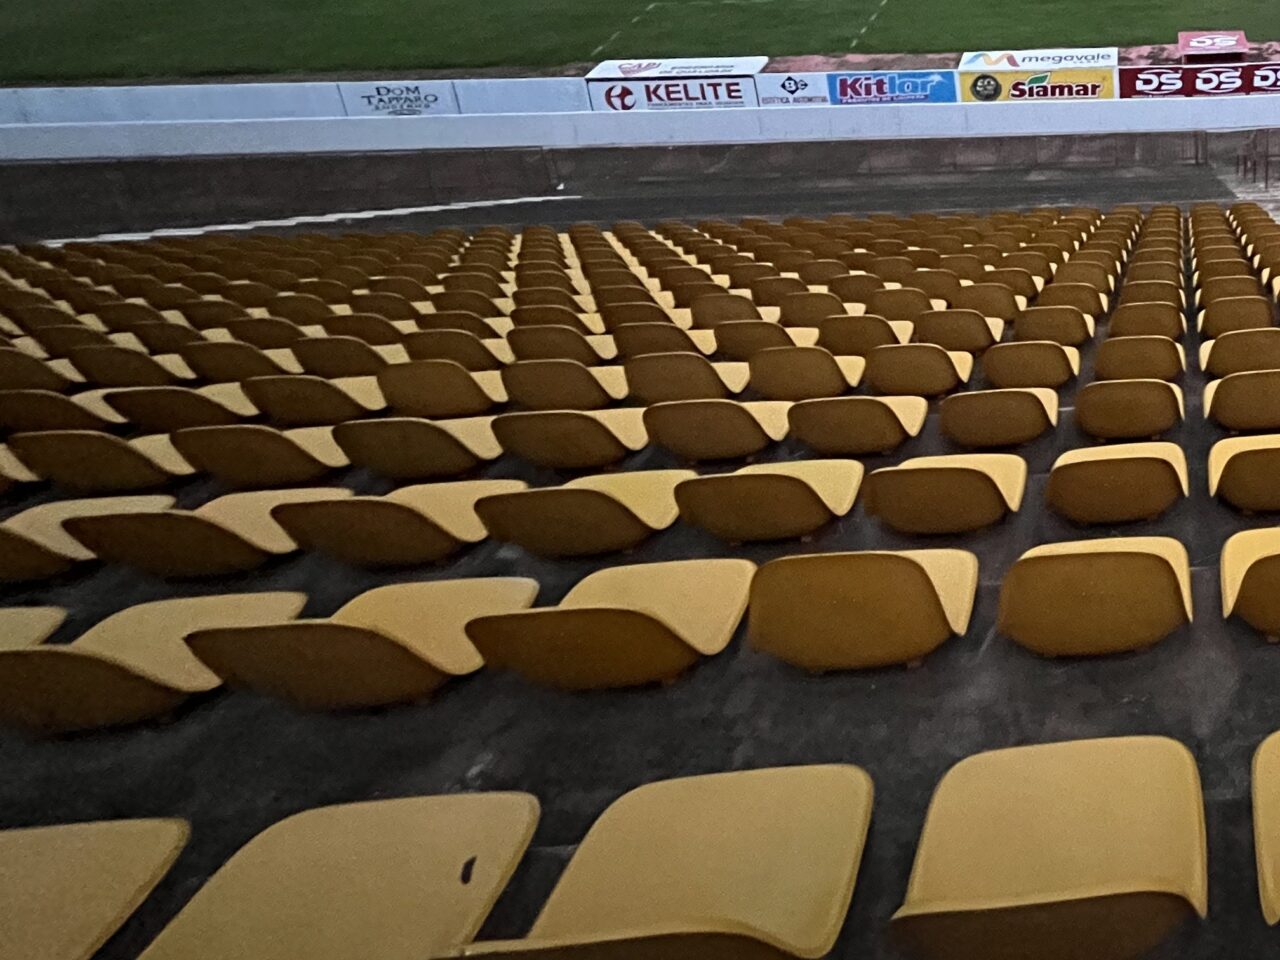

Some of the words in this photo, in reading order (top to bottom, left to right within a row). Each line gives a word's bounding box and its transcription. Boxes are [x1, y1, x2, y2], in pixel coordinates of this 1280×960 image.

[1189, 35, 1240, 47] DS
[1021, 53, 1111, 64] megavale
[1136, 70, 1183, 91] DS
[1195, 70, 1243, 91] DS
[375, 86, 420, 96] DOM
[644, 82, 743, 102] KELITE
[1010, 81, 1102, 98] Siamar
